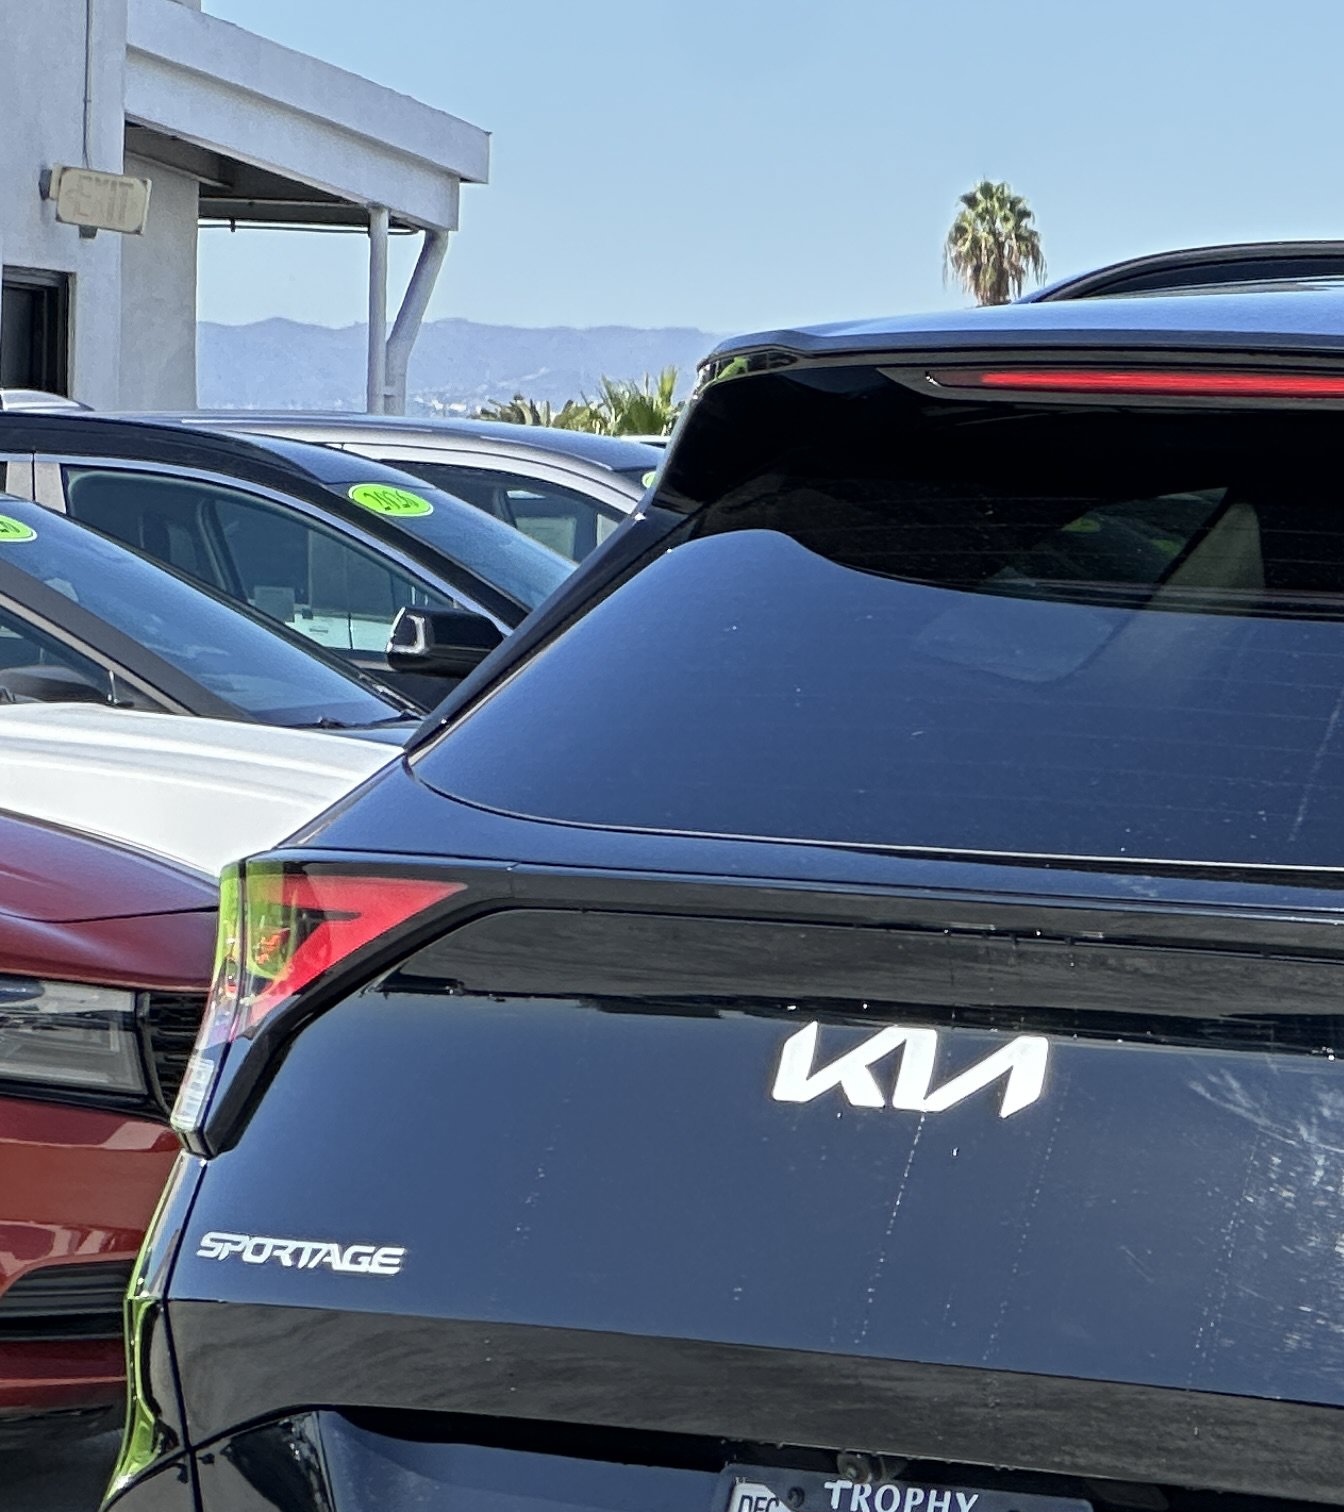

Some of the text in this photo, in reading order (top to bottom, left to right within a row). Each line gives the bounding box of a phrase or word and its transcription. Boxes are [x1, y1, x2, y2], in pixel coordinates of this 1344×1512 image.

[73, 174, 134, 225] EXIT
[772, 1020, 1051, 1119] KIA
[197, 1230, 407, 1275] SPORTAGE
